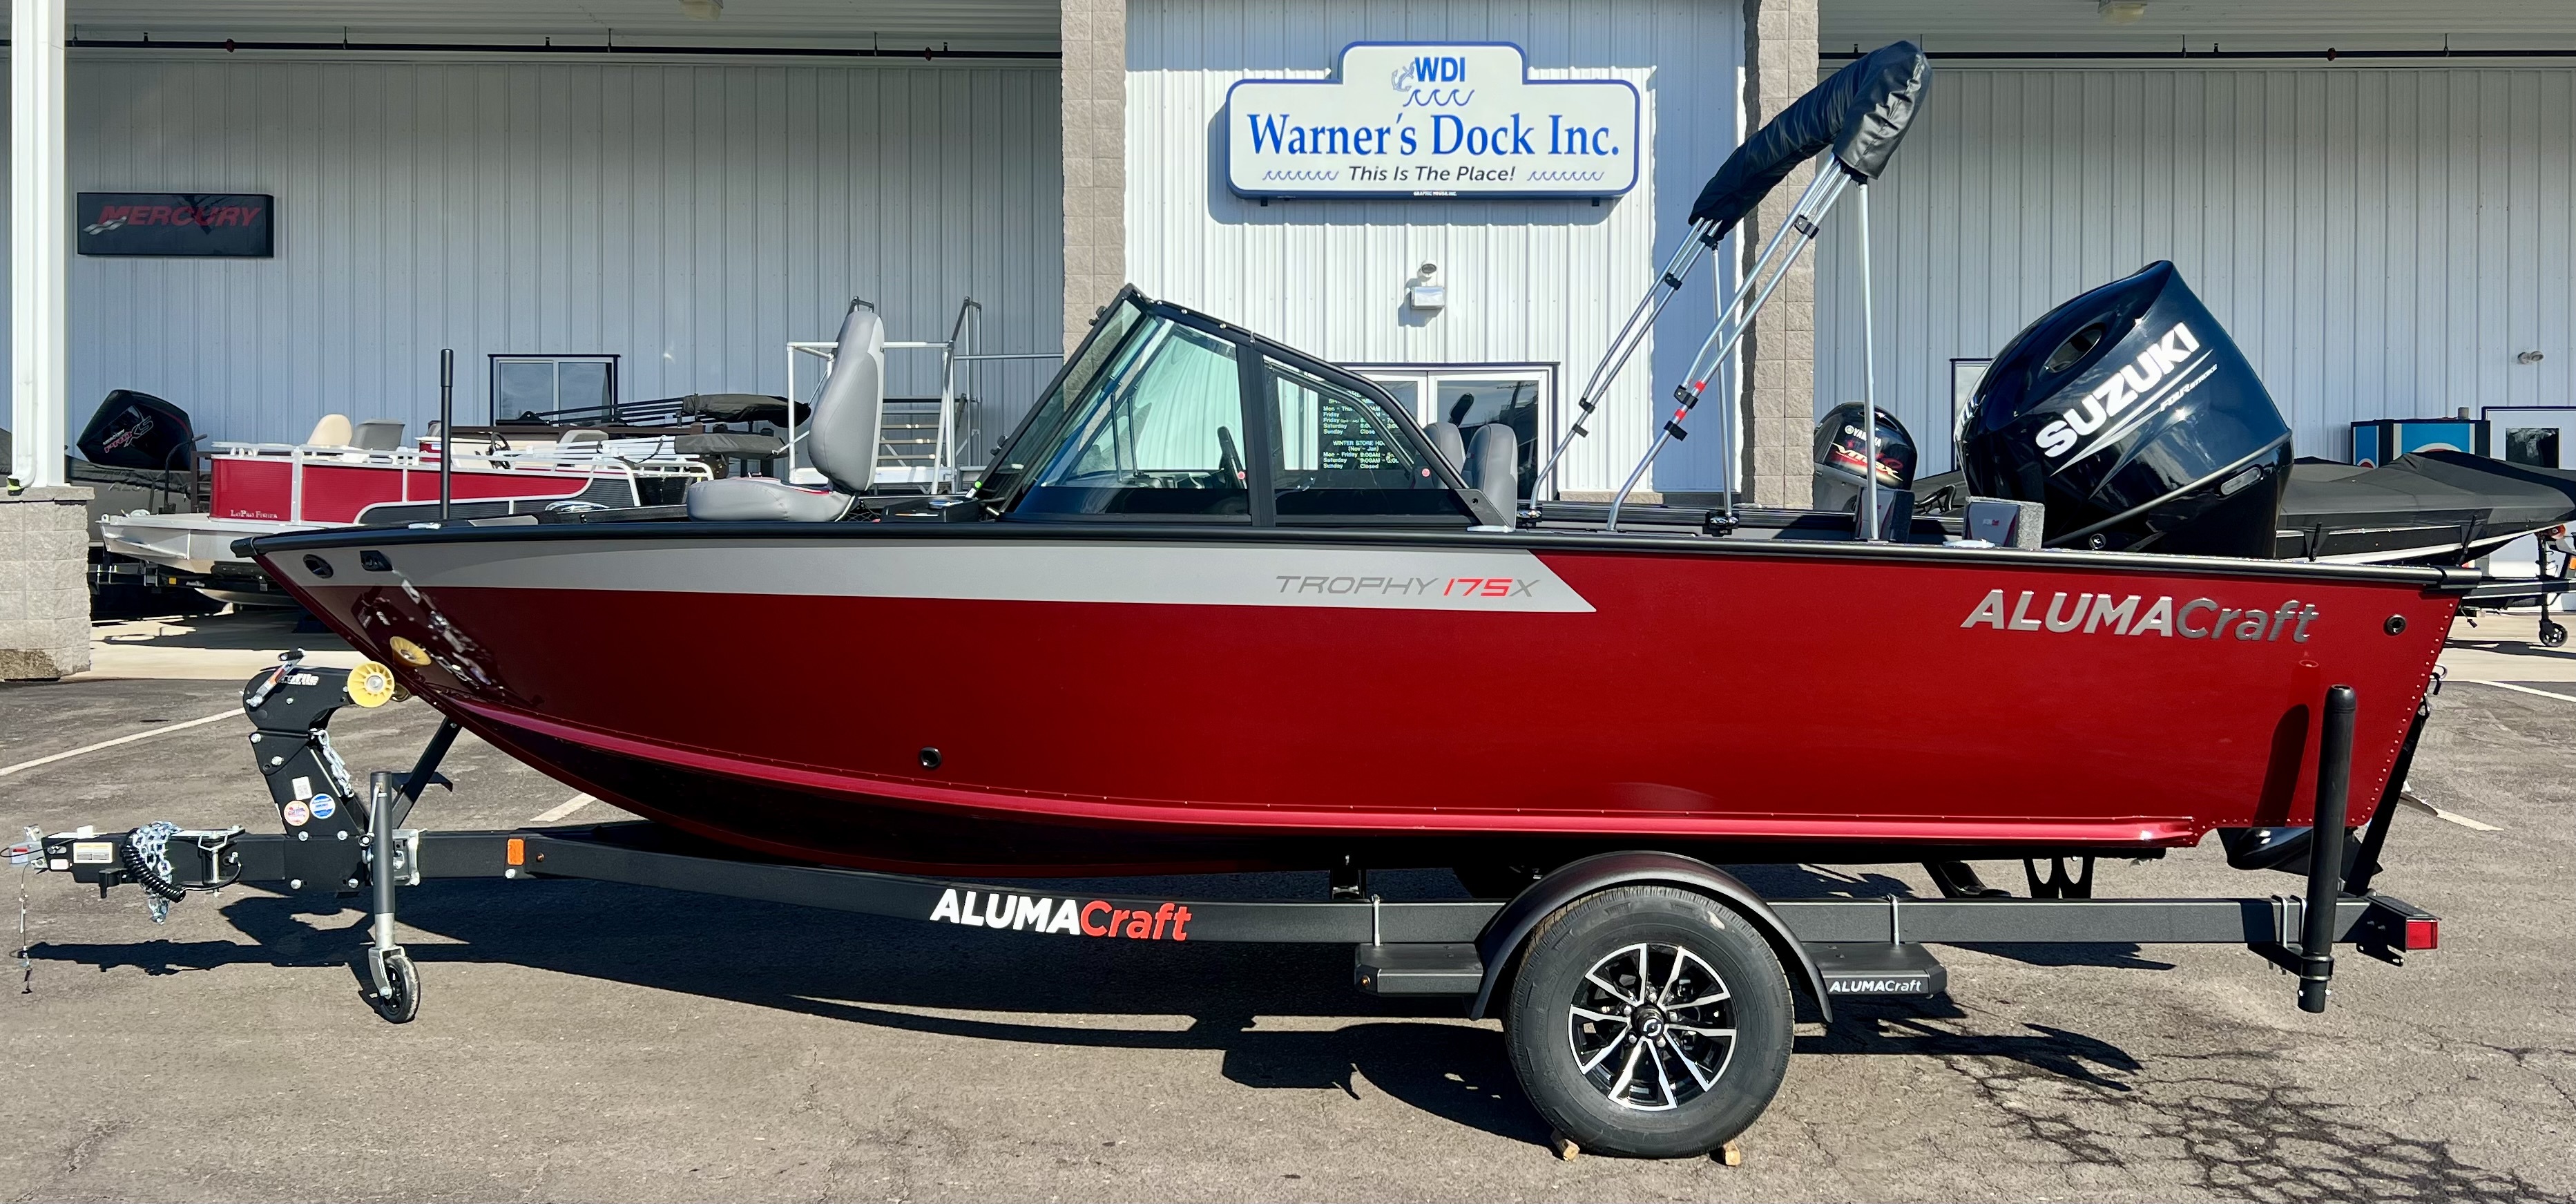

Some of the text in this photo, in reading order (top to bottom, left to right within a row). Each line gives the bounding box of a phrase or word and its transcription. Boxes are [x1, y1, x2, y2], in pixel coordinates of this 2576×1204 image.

[1414, 57, 1466, 82] WDI
[1247, 112, 1619, 155] Warner's Dock Inc.
[1349, 166, 1516, 181] This Is The Place!
[98, 204, 262, 227] MERCURY
[2035, 321, 2200, 457] SUZUKI
[1276, 575, 1540, 597] TROPHY 175X
[1959, 589, 2320, 643] ALUMACraft
[929, 888, 1192, 942] ALUMACraft
[1829, 980, 1922, 993] ALUMACraft
